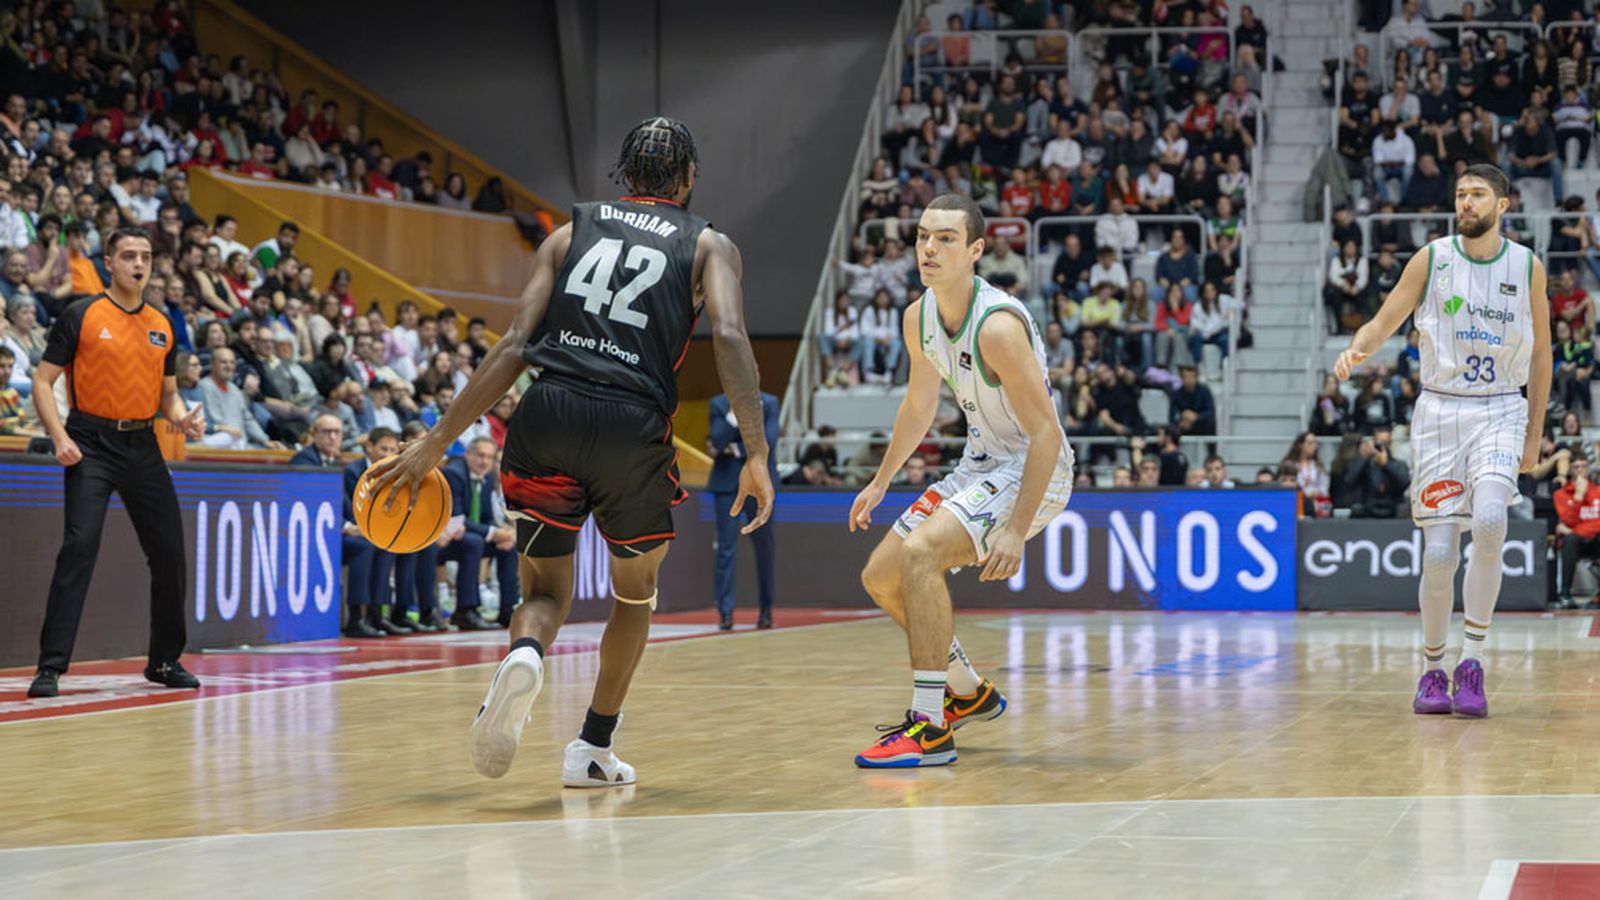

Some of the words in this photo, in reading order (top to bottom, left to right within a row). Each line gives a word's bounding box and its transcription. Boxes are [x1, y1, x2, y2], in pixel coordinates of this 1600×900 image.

[600, 204, 678, 238] DURHAM
[564, 237, 667, 330] 42
[1466, 302, 1515, 324] Unicaja
[559, 329, 597, 349] Kave
[599, 338, 641, 365] Home
[1463, 354, 1496, 383] 33
[195, 500, 335, 623] IONOS
[1304, 529, 1534, 577] enda
